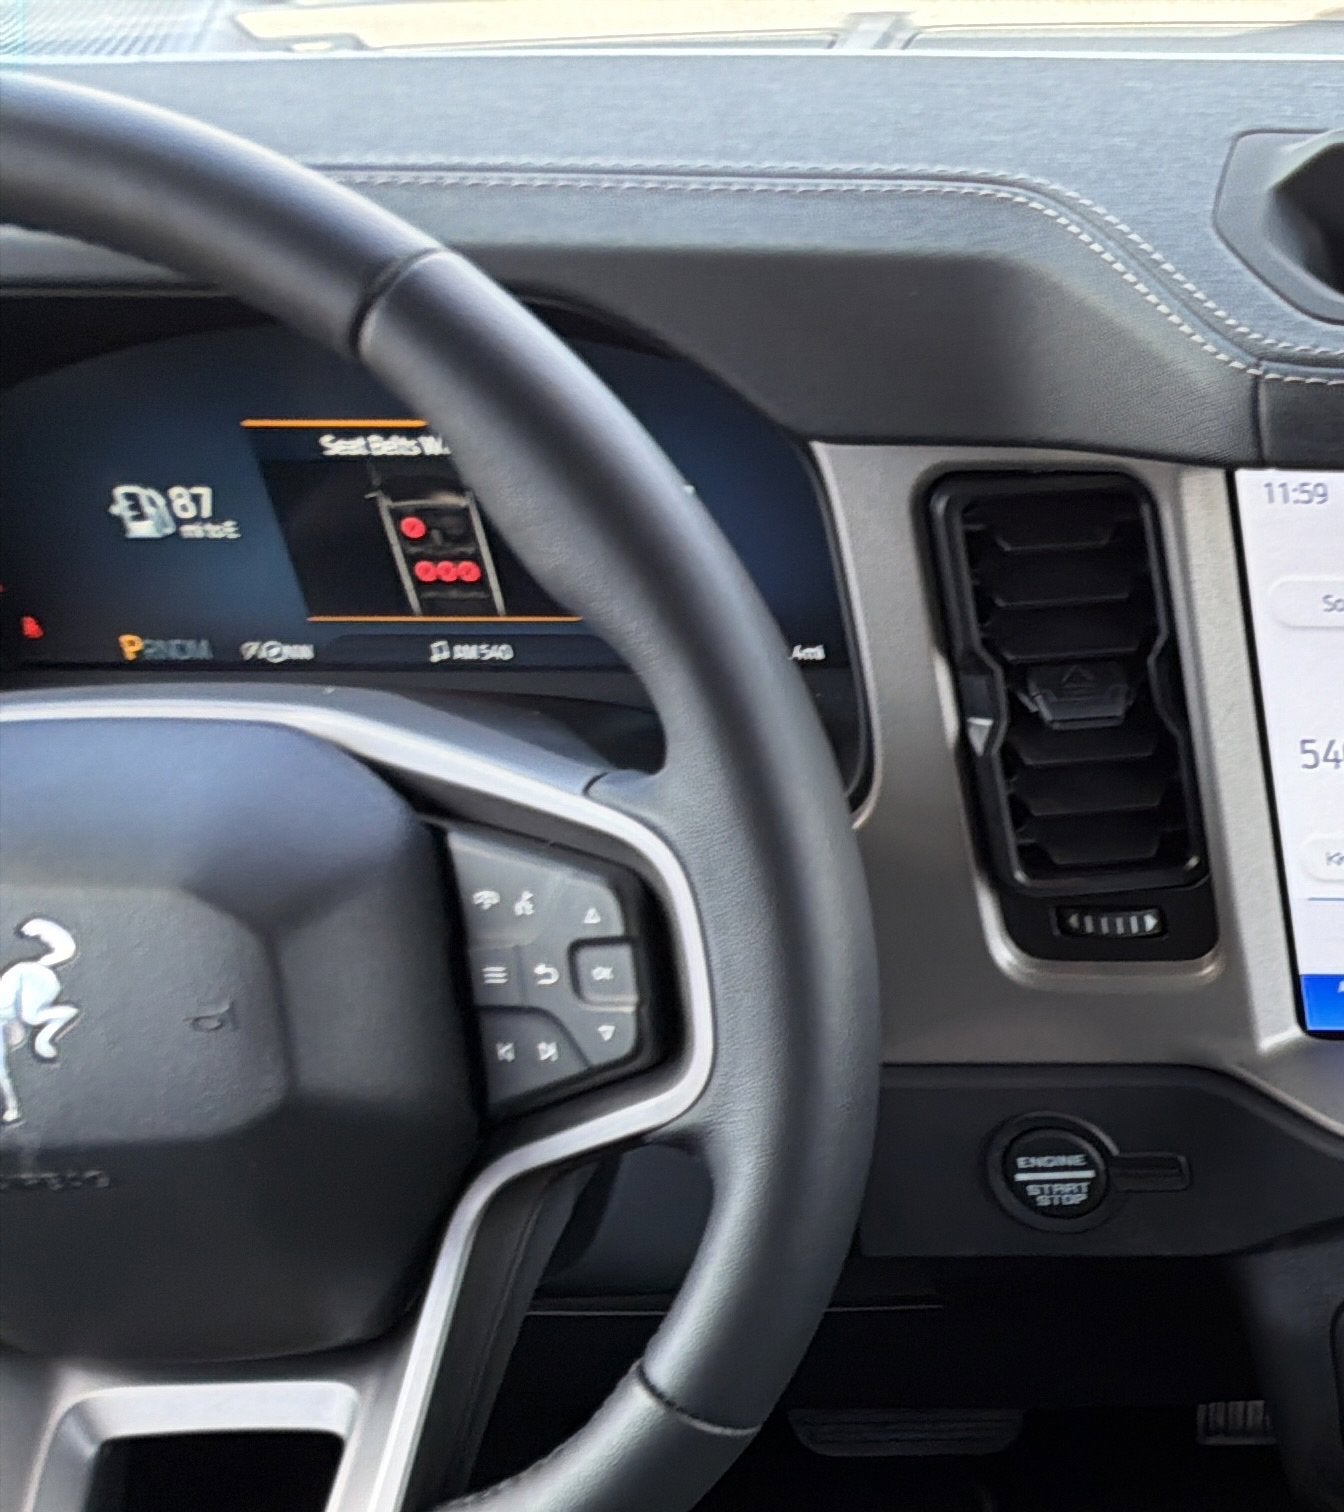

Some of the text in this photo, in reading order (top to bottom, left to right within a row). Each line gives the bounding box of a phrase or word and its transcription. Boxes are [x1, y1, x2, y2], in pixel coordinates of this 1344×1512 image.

[1263, 482, 1329, 505] 11:59
[167, 485, 213, 520] 87
[1015, 1153, 1089, 1170] ENGINE
[1025, 1181, 1092, 1197] START
[1035, 1194, 1089, 1207] STOP
